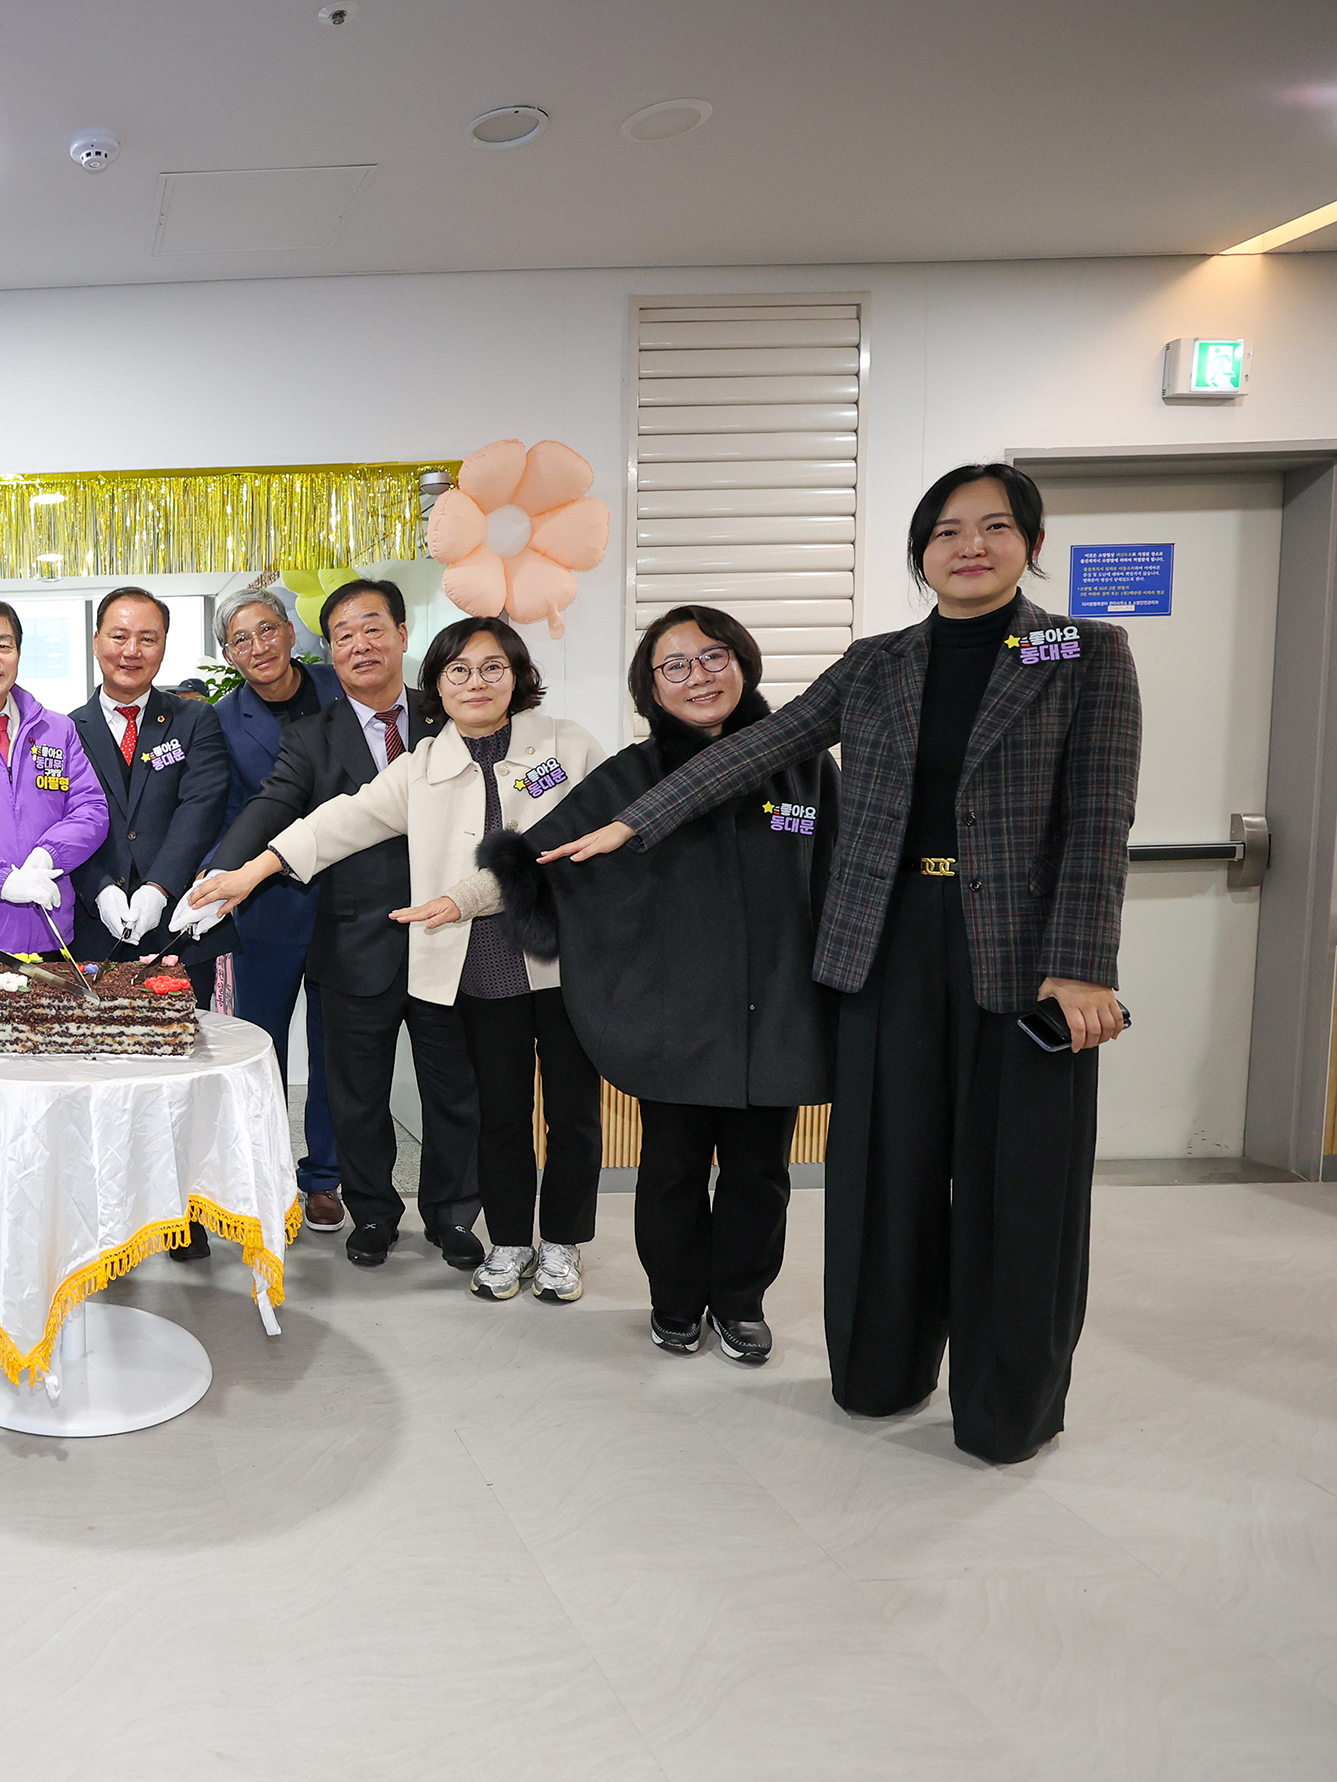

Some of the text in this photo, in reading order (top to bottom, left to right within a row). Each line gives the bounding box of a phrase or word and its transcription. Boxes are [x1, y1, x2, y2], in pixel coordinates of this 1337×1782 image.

[1029, 625, 1081, 646] 좋아요
[1019, 640, 1081, 665] 동대문
[152, 738, 182, 757] 좋아요
[36, 756, 62, 769] 동대문
[151, 747, 186, 771] 동대문
[526, 758, 560, 782] 좋아요
[36, 775, 70, 791] 이필형
[527, 767, 567, 797] 동대문
[780, 802, 816, 820] 좋아요
[770, 814, 815, 836] 동대문
